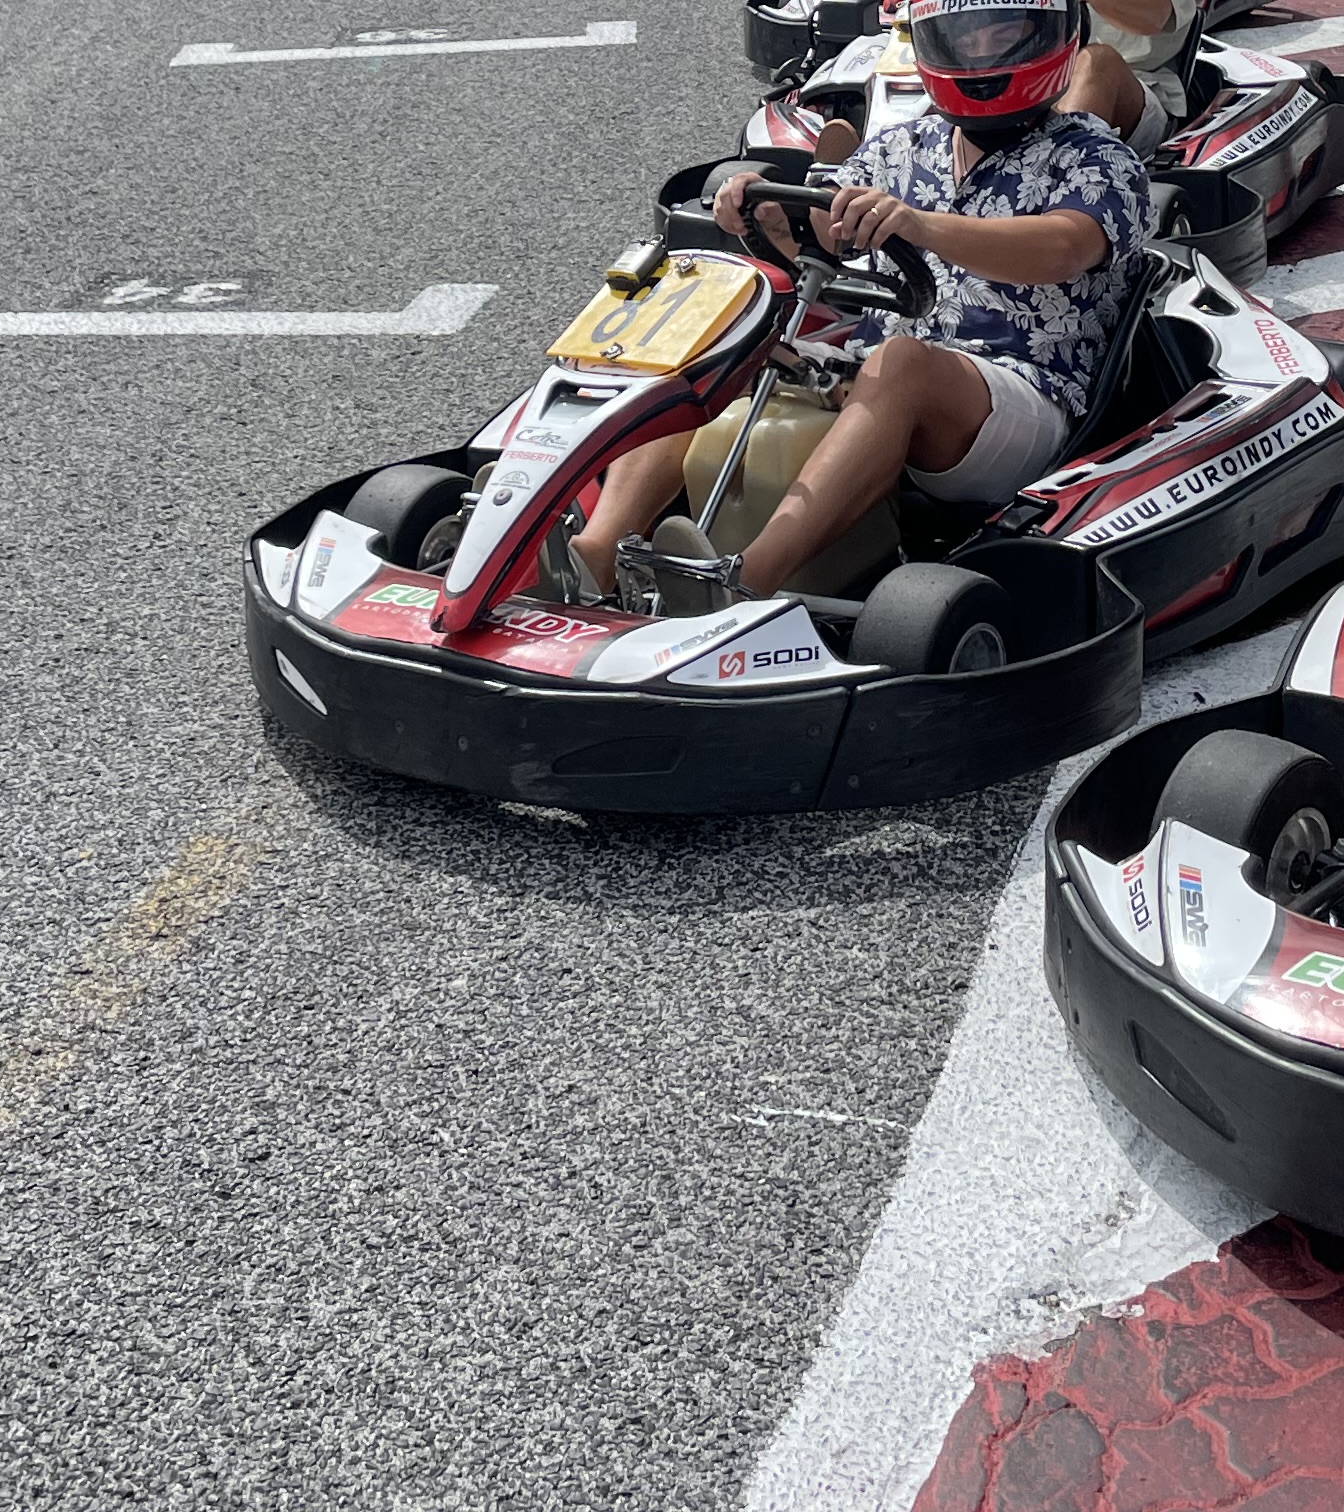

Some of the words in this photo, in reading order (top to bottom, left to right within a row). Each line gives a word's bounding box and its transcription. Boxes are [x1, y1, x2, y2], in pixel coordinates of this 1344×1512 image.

[1209, 91, 1312, 167] WWW.EUROINDY.COM
[591, 279, 703, 347] 81
[1254, 318, 1303, 376] FERBERTO
[504, 450, 559, 464] FERBERTO
[1083, 401, 1337, 546] WWW.EUROINDY.COM
[752, 645, 820, 669] SODI
[1128, 878, 1153, 932] SODI
